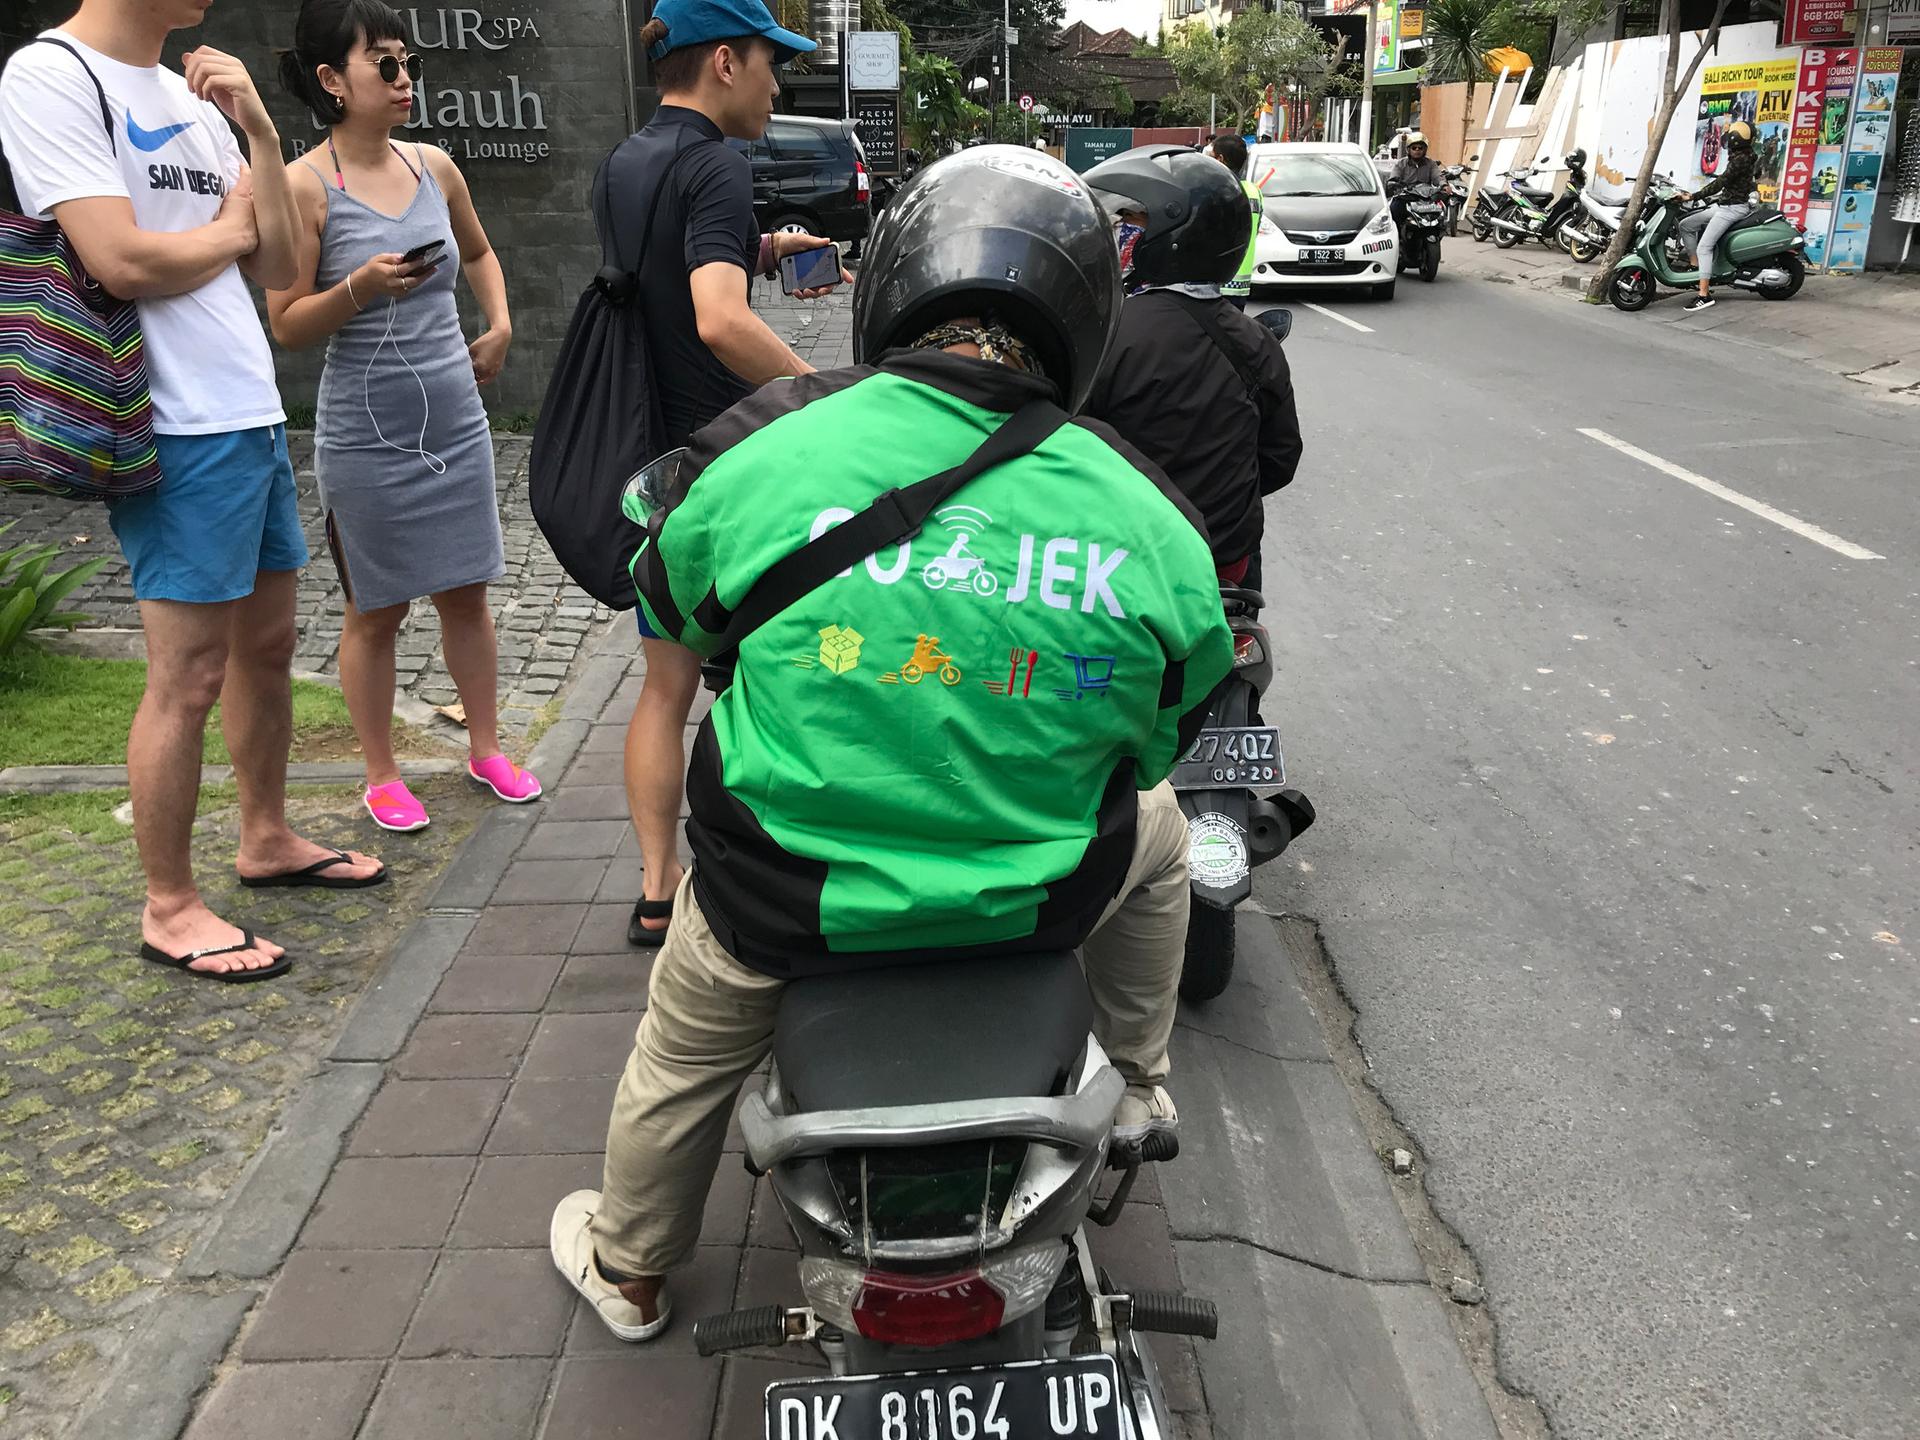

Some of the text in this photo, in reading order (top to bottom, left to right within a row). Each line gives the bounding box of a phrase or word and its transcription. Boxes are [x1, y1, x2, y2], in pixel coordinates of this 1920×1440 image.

[1825, 1, 1846, 9] BESAR
[1891, 0, 1910, 12] CKY
[1803, 11, 1822, 21] 6GB
[394, 8, 541, 50] UR SPA
[1867, 50, 1901, 59] WATER SPORT
[1827, 66, 1856, 76] TOURIST
[1866, 61, 1900, 71] ADVENTURE
[1704, 72, 1719, 84] BALI
[1721, 69, 1743, 82] RICKY
[1743, 67, 1764, 80] TOUR
[1764, 72, 1797, 83] BOOK HERE
[1796, 49, 1826, 128] BIKE
[1708, 99, 1732, 113] BMW
[1760, 89, 1792, 113] ATV
[859, 110, 894, 118] FRESH
[1071, 114, 1092, 124] AYU
[1758, 113, 1790, 122] ADVENTURE
[1796, 128, 1816, 136] FOR
[1791, 137, 1818, 145] RENT
[464, 139, 549, 163] Lounge
[148, 164, 185, 191] SAN
[1783, 147, 1810, 227] LAUNDR
[1362, 239, 1393, 256] momo
[1300, 250, 1344, 260] DK 1522 SE
[1006, 534, 1131, 619] JEK
[781, 1394, 842, 1440] DK
[1046, 1372, 1111, 1435] UP
